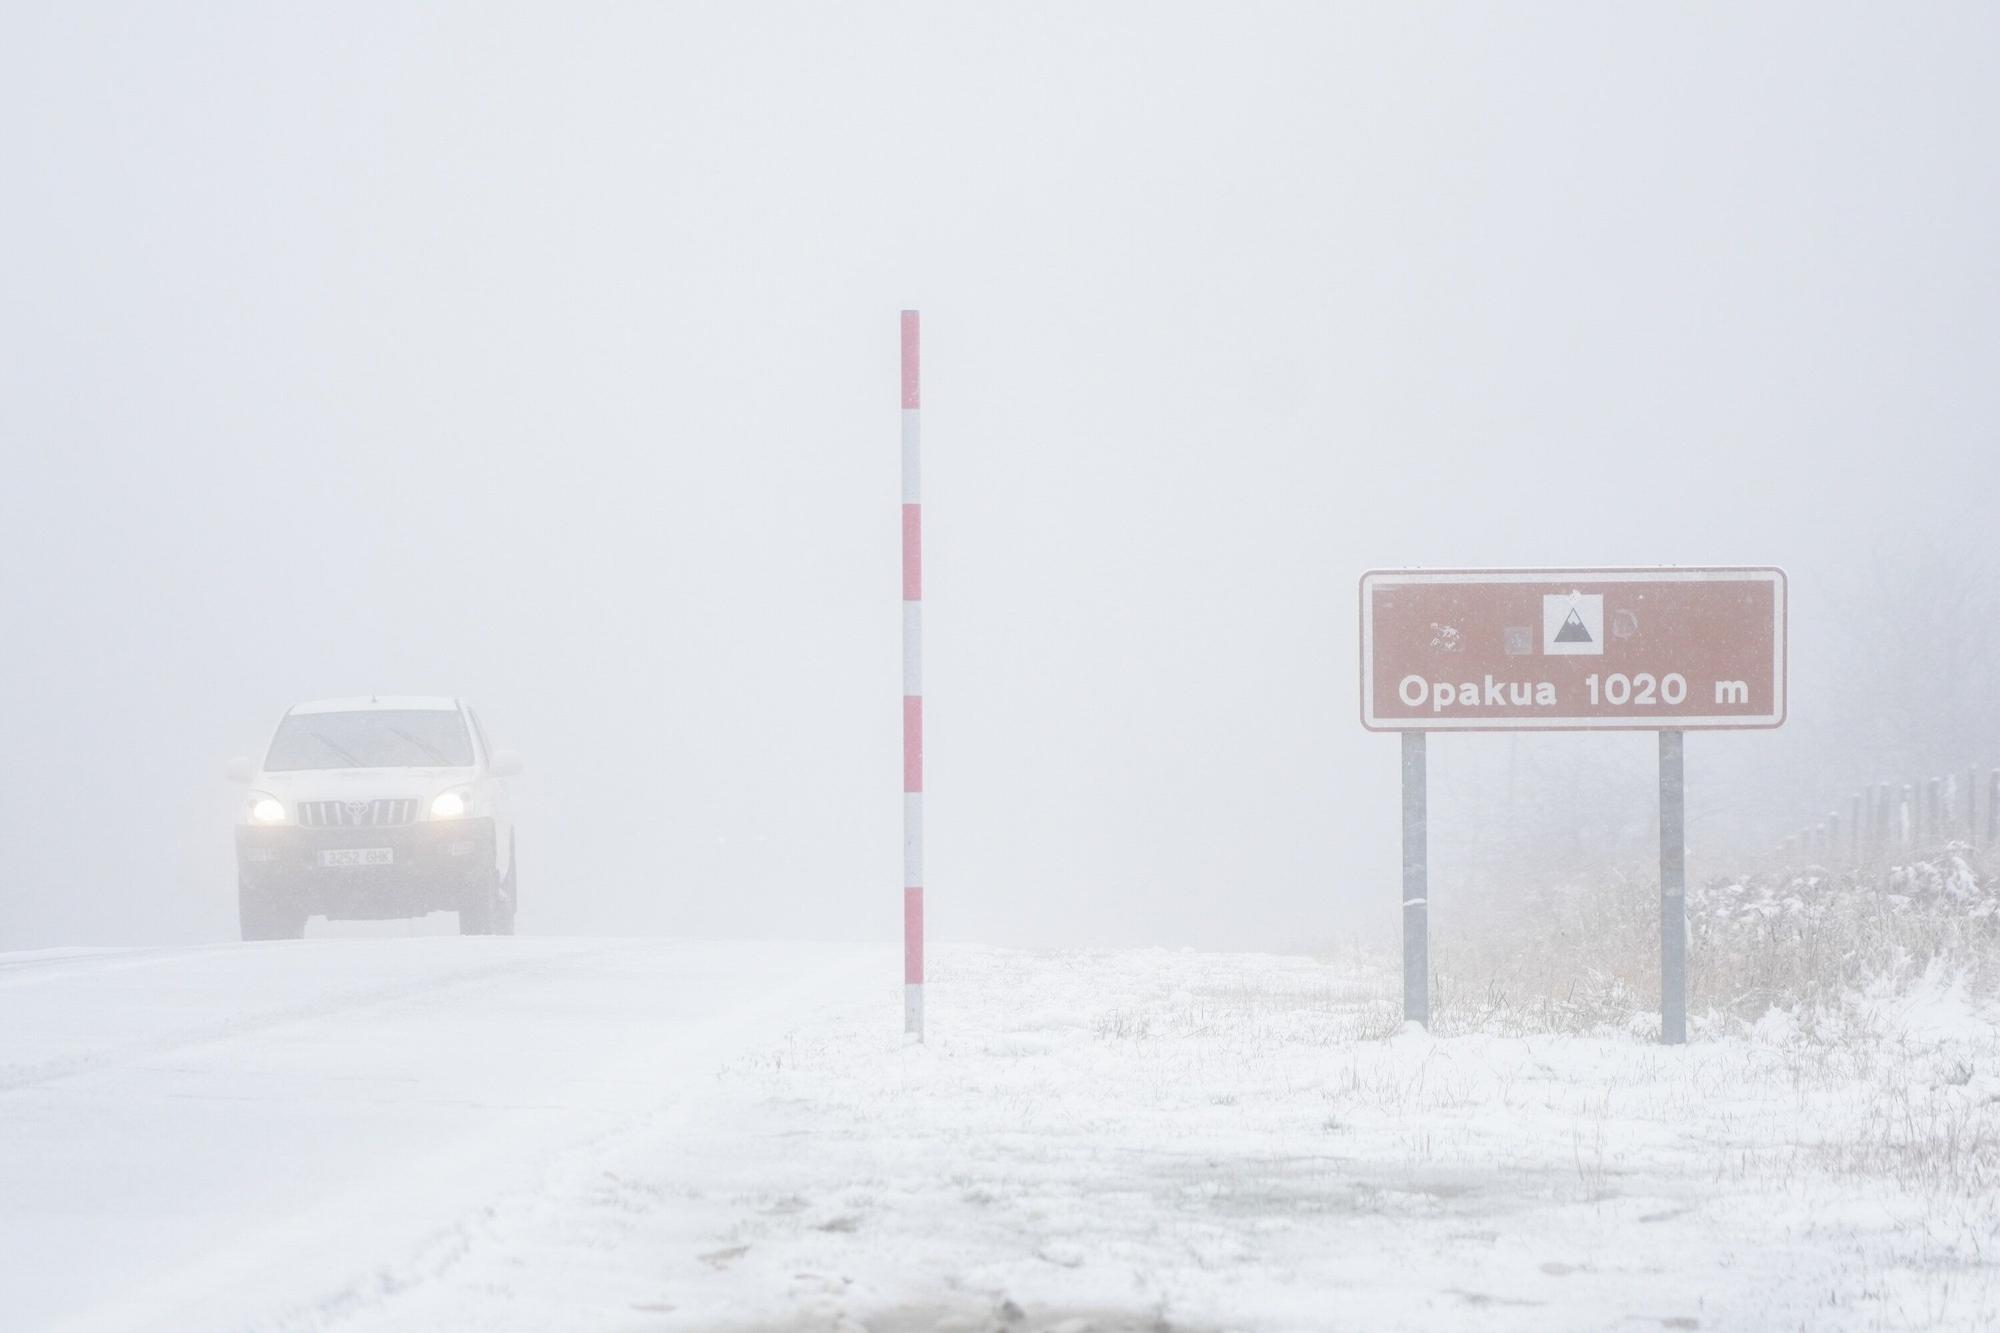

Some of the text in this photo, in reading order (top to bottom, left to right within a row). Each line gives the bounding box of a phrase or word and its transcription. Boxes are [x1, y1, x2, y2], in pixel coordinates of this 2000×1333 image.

[1398, 672, 1749, 713] Opakua 1020 m
